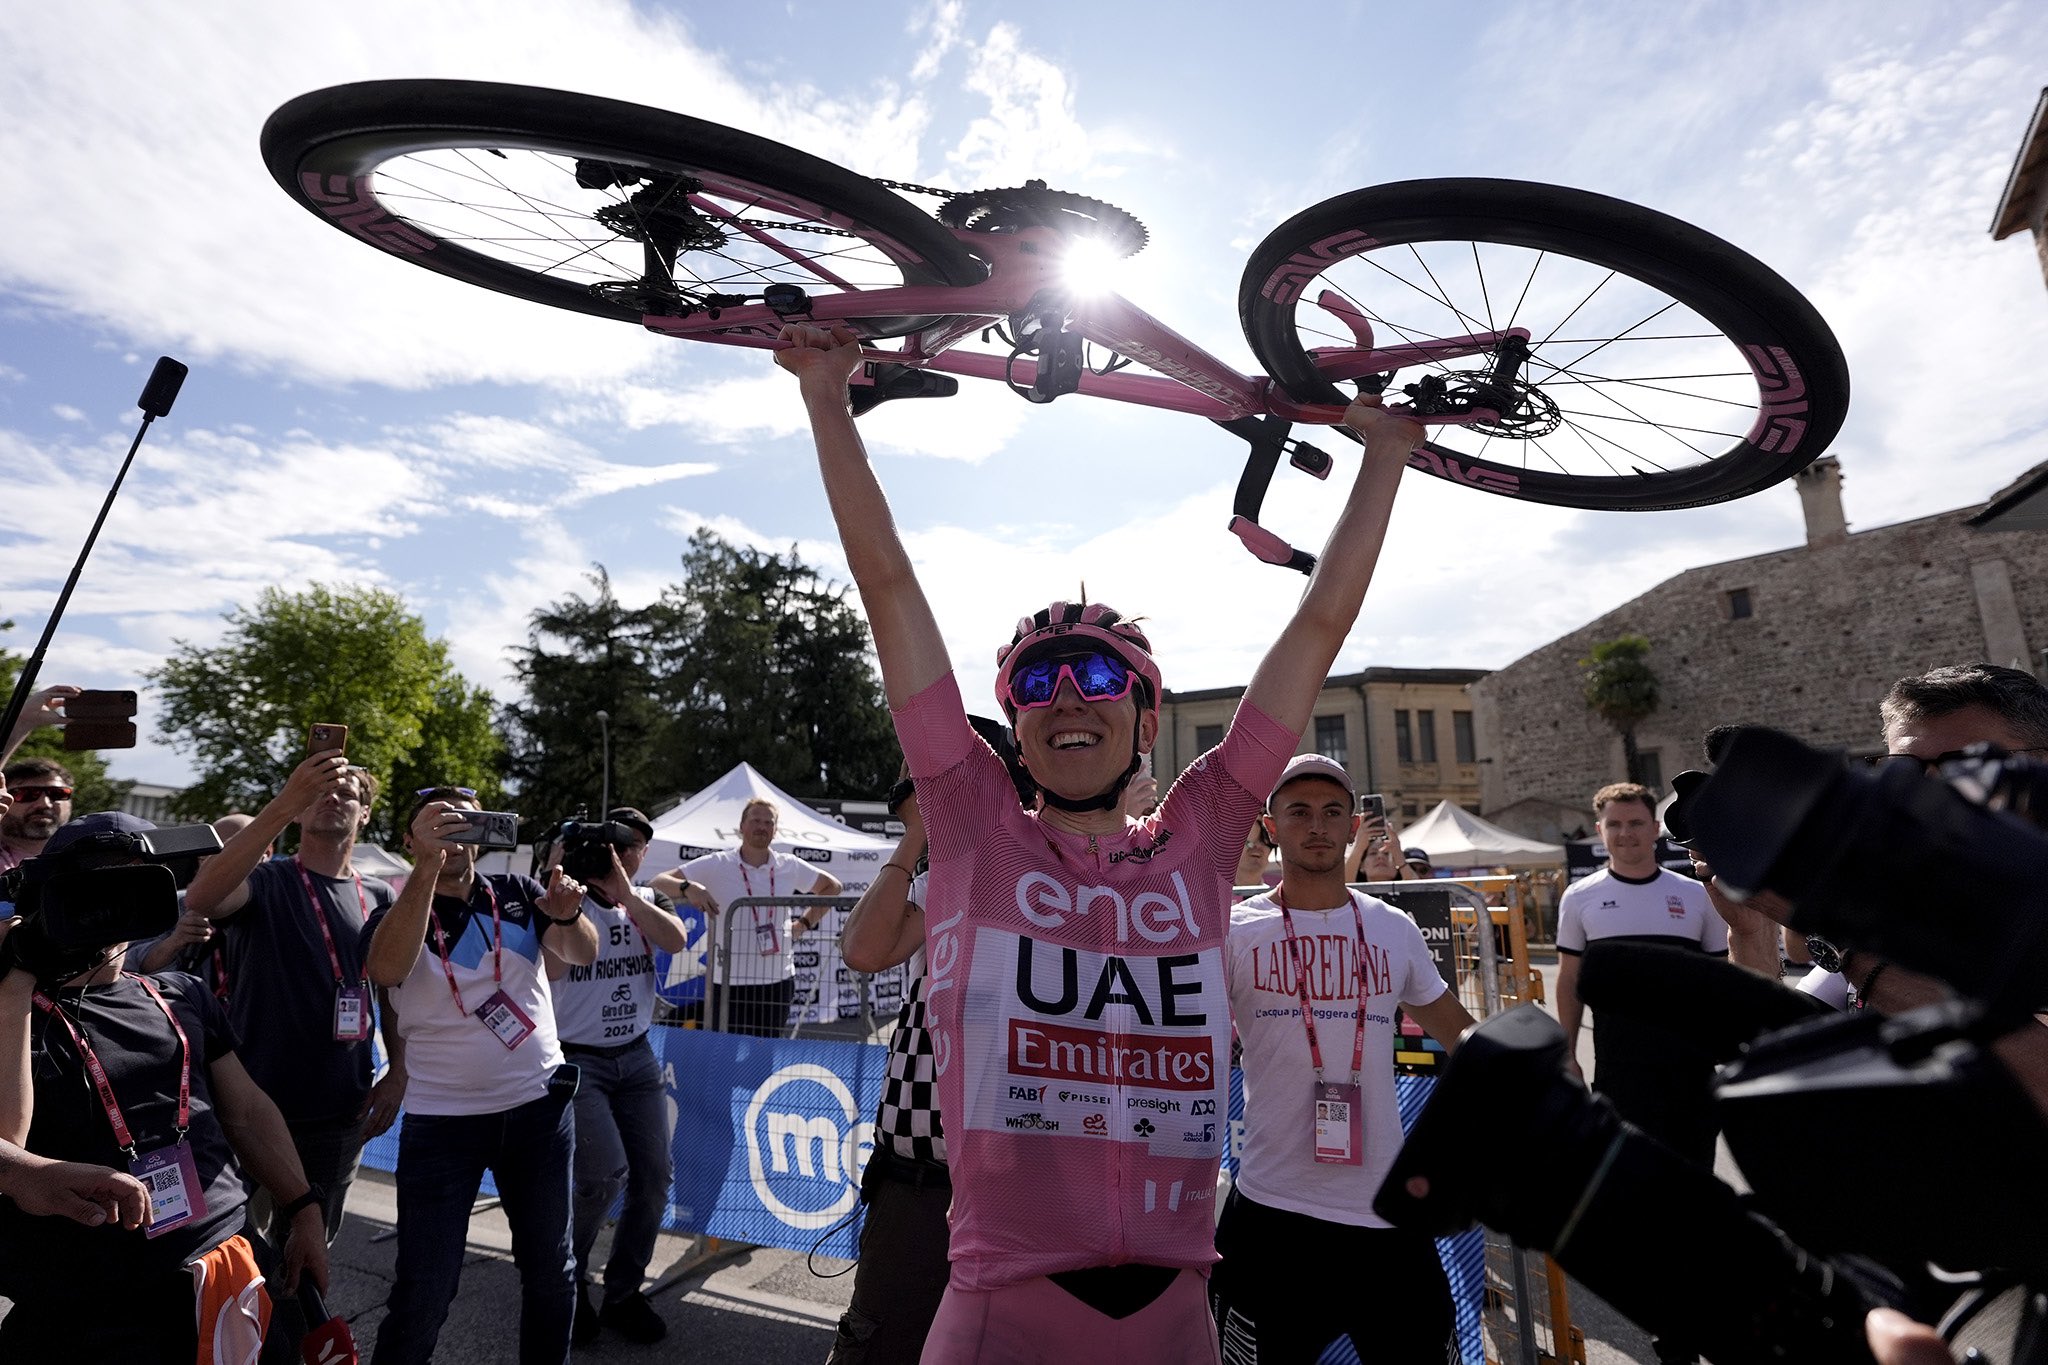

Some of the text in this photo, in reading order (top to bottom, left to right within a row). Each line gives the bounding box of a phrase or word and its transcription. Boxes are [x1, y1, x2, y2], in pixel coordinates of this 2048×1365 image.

[1036, 624, 1075, 637] MET
[1016, 871, 1200, 943] enel
[1422, 927, 1449, 940] ONI
[568, 964, 592, 982] NON
[1252, 935, 1392, 1001] LAURETANA
[1016, 934, 1207, 1026] UAE
[927, 910, 963, 1076] enel
[1310, 1007, 1349, 1019] leggera
[1351, 1010, 1389, 1024] duropa
[604, 1023, 634, 1038] 2024
[1015, 1027, 1211, 1084] Emirates
[1071, 1094, 1110, 1104] PISSEI
[1128, 1097, 1180, 1114] presight
[1190, 1099, 1216, 1116] ADQ
[1005, 1116, 1059, 1130] WHOOSH
